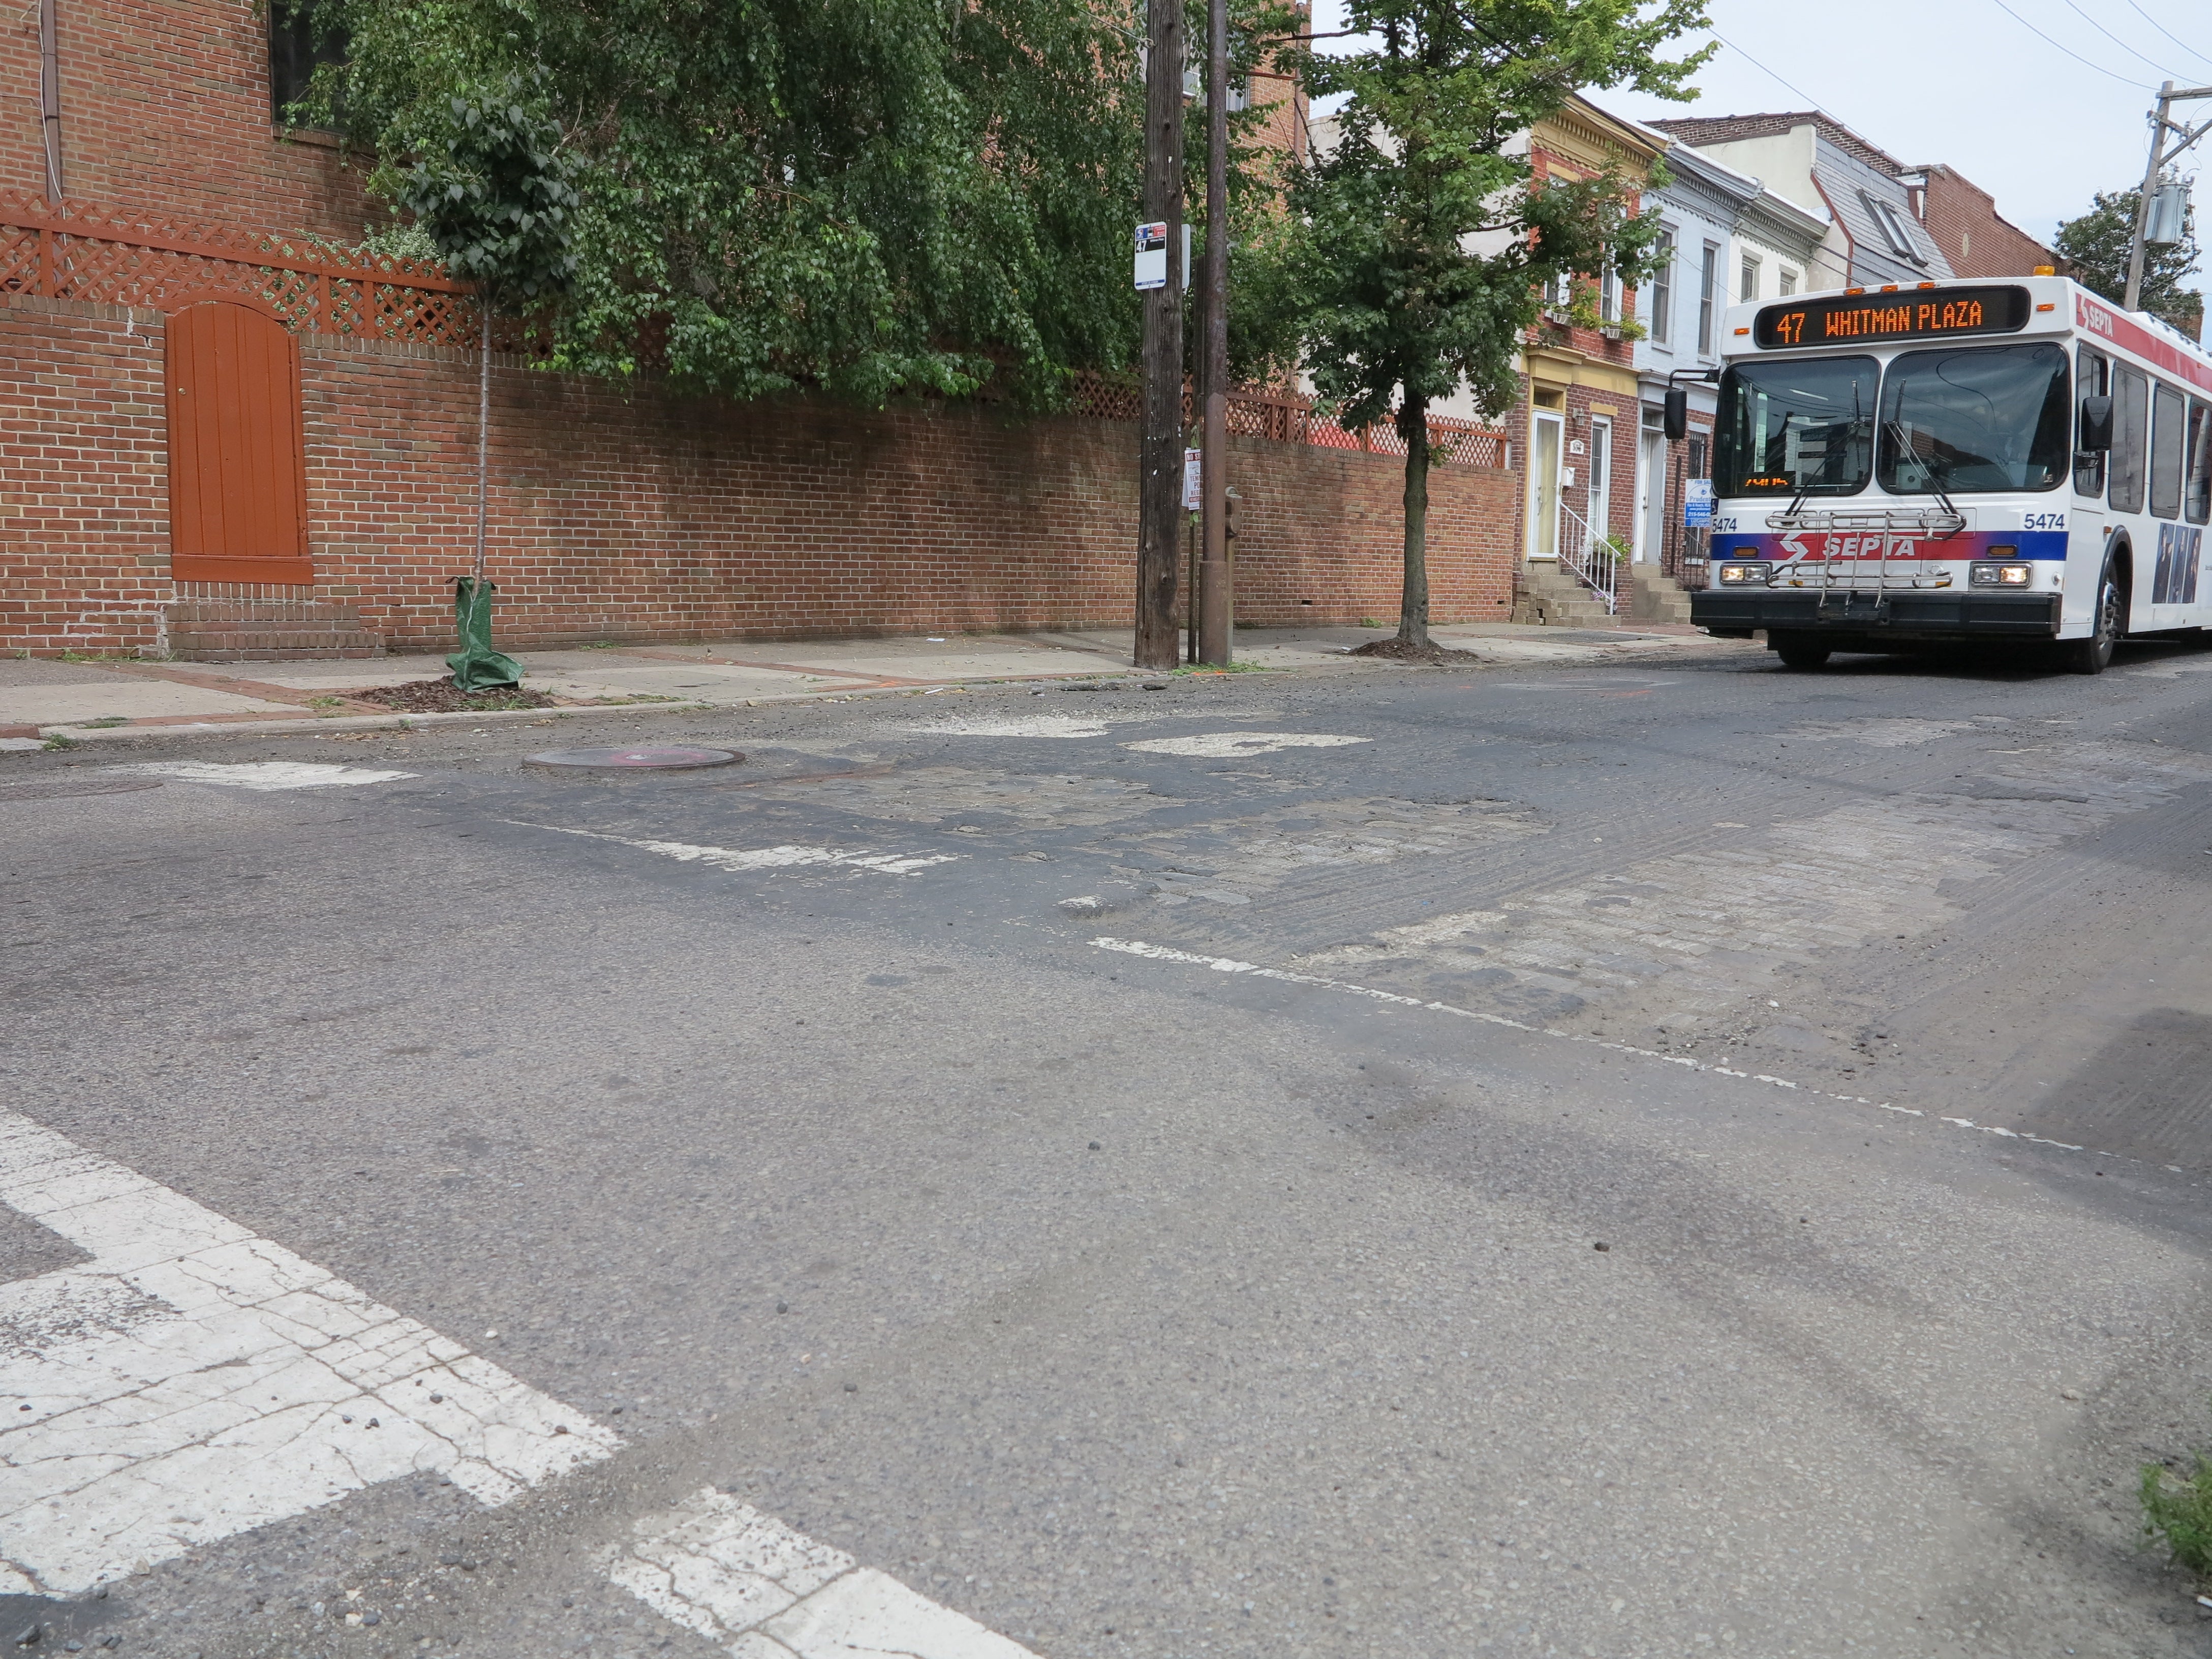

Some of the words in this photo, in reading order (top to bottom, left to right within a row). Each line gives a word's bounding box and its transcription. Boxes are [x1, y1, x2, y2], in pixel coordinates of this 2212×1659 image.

[1136, 240, 1147, 252] 47
[1777, 313, 1805, 344] 47
[1826, 305, 1911, 337] WHITMAN
[1918, 300, 1982, 330] PLAZA
[2088, 304, 2113, 337] SEPTA
[1712, 517, 1737, 533] 5474
[2024, 513, 2065, 529] 5474
[1822, 537, 1915, 557] SEPTA
